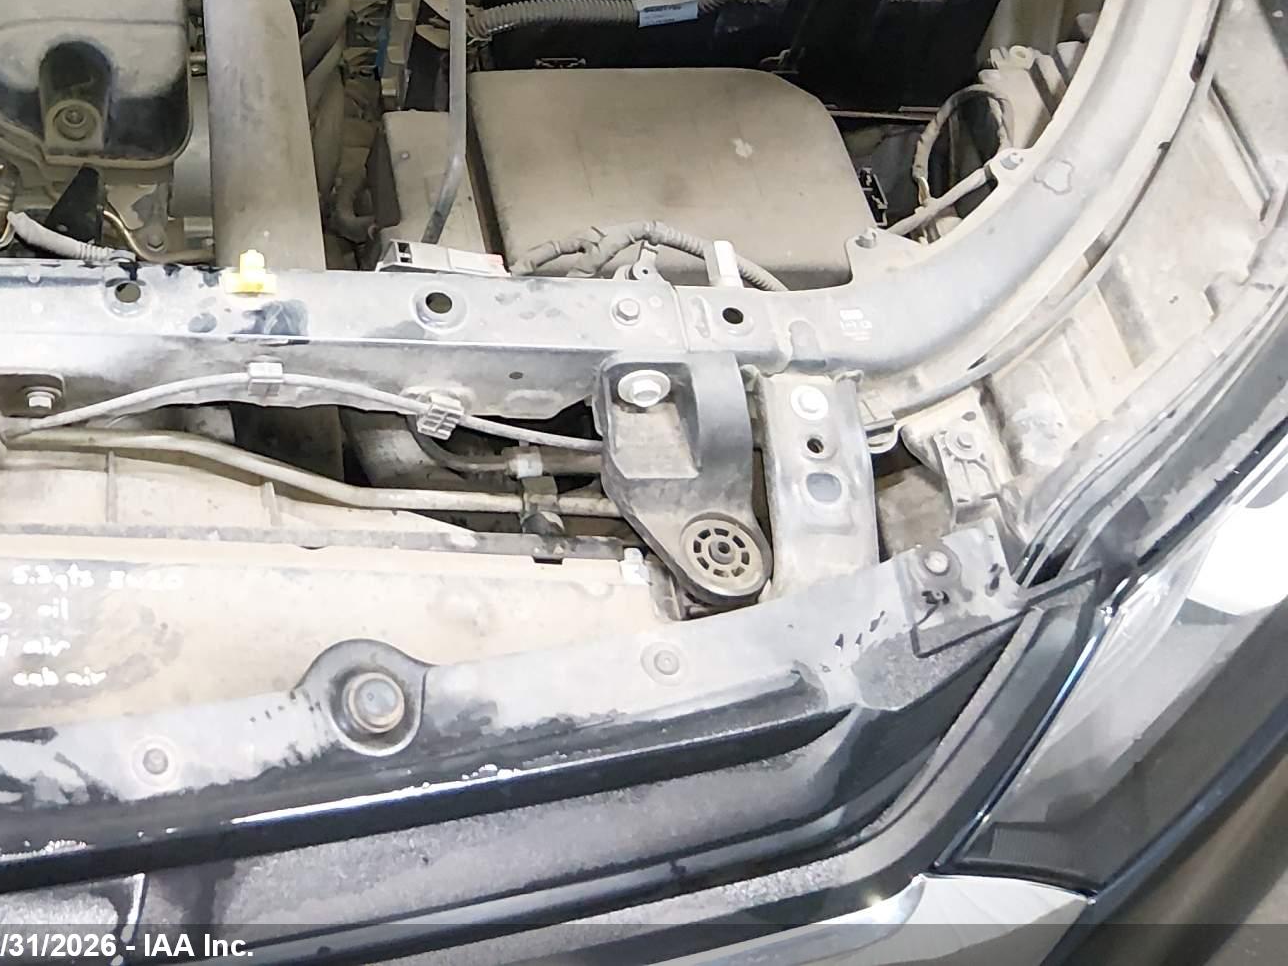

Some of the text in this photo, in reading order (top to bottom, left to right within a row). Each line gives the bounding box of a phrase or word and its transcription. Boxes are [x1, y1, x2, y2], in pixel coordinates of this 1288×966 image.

[12, 564, 95, 591] 5.3qts
[37, 597, 69, 621] oil
[22, 636, 71, 656] air
[13, 666, 60, 687] cab
[64, 666, 107, 686] air
